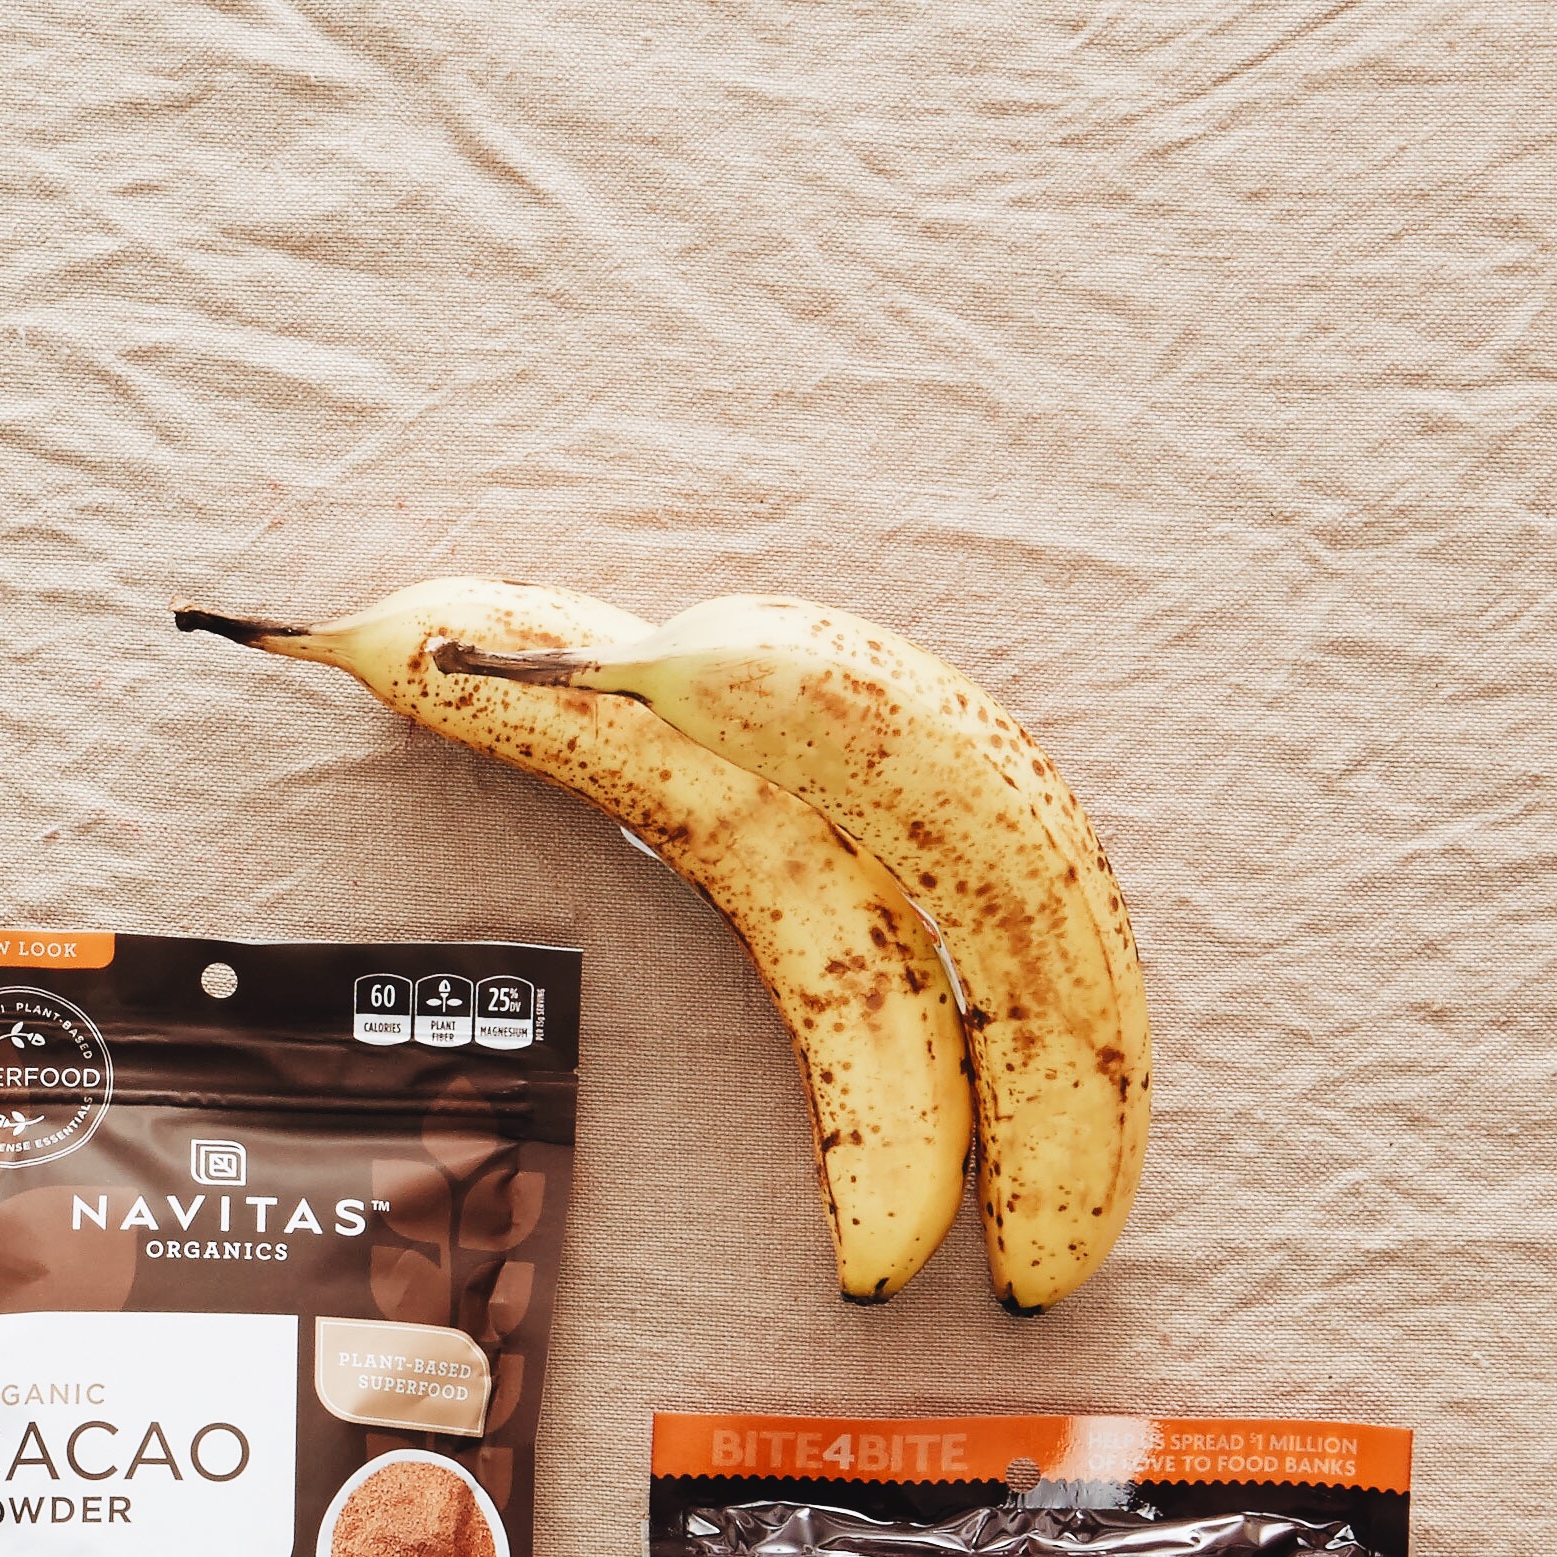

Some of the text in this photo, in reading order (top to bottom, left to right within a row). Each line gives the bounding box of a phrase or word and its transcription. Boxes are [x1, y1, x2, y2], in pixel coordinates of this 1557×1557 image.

[18, 941, 77, 958] LOOK
[371, 984, 395, 1008] 60
[488, 987, 510, 1012] 25
[16, 1002, 93, 1060] PLANT-BASED
[364, 1022, 401, 1033] CALORIES
[431, 1020, 456, 1031] PLANT
[480, 1026, 528, 1038] MAGNESIUM
[35, 1095, 93, 1149] ESSENTIALS
[146, 1239, 288, 1262] ORGANICS
[339, 1352, 472, 1380] PLANT-BASED
[358, 1374, 468, 1402] SUPERFOOD
[711, 1430, 968, 1473] BITE4BITE
[1170, 1433, 1358, 1455] SPREAD MILLION
[1181, 1455, 1356, 1477] TO FOOD BANKS
